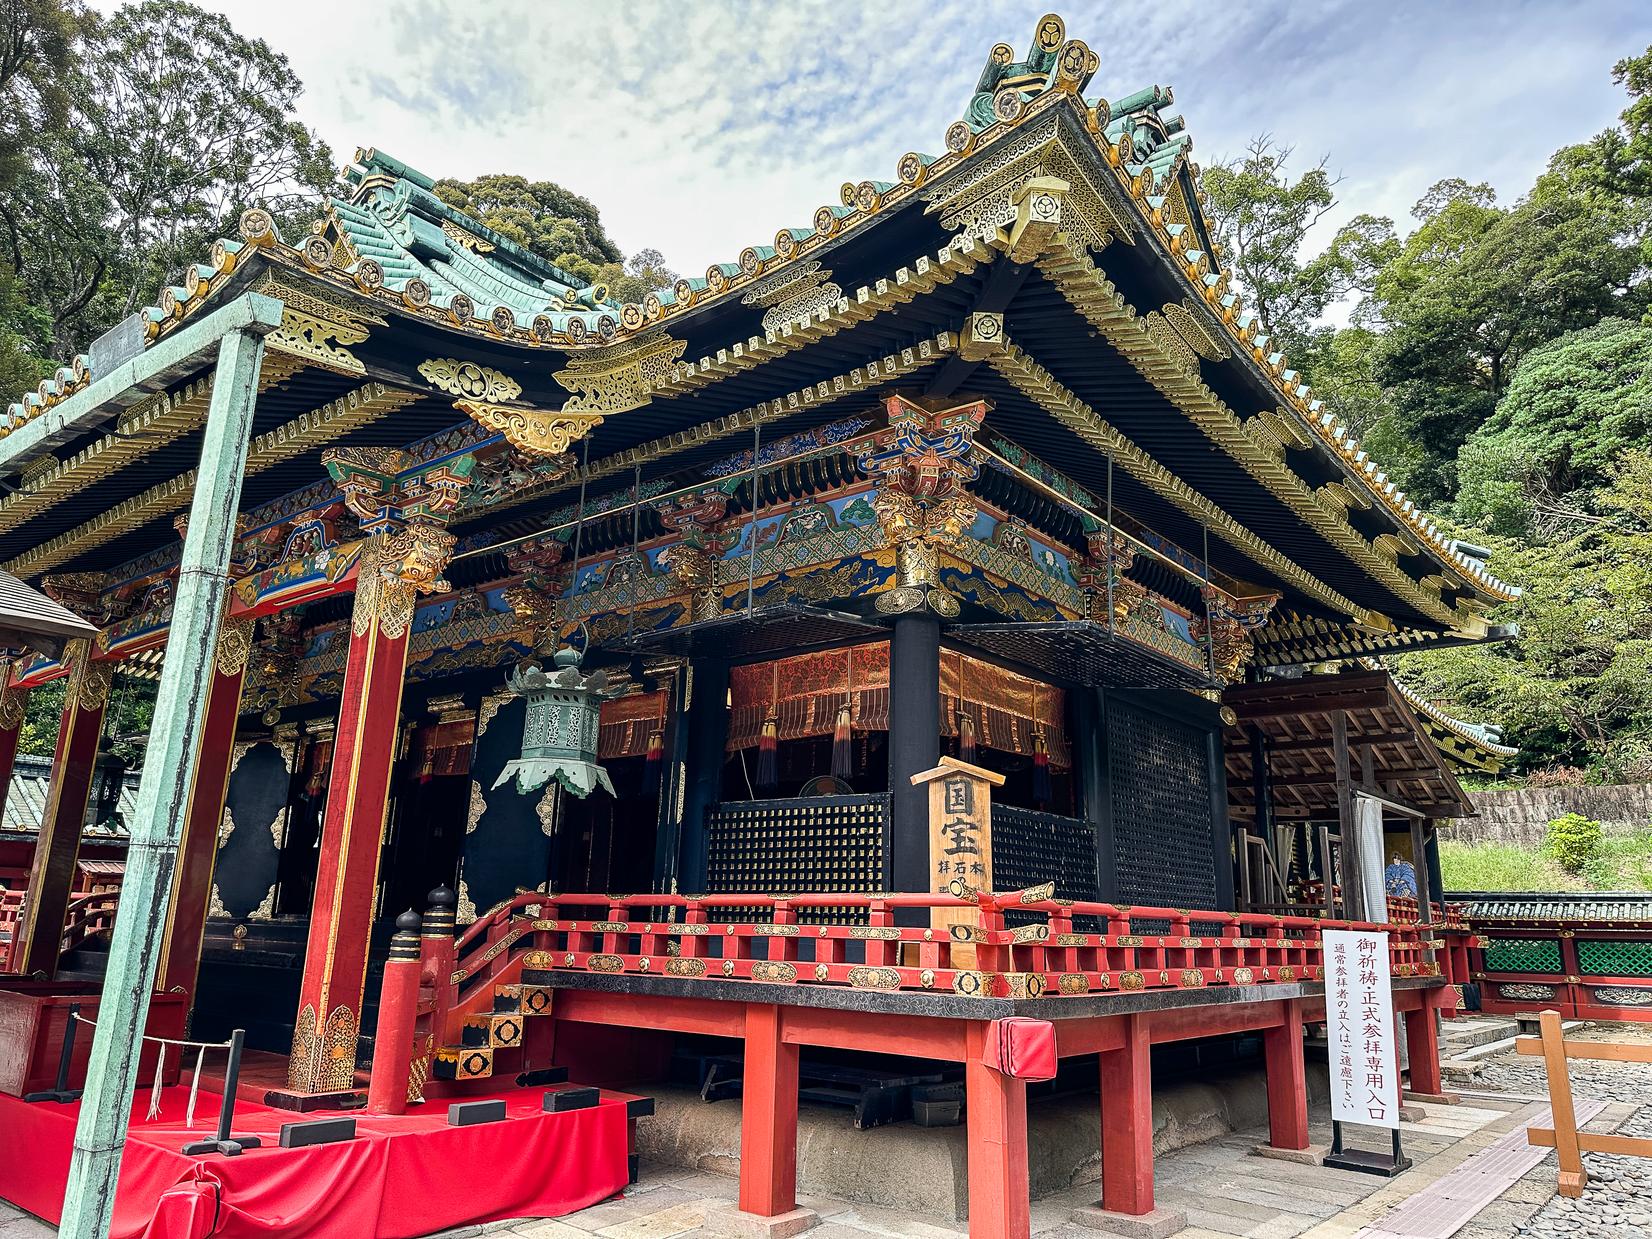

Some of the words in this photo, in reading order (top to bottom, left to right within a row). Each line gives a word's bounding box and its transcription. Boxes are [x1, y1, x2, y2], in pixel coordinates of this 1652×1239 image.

[942, 779, 978, 855] 国宝
[1333, 943, 1355, 1109] 通常参拝者の立入はご遠慮下さい
